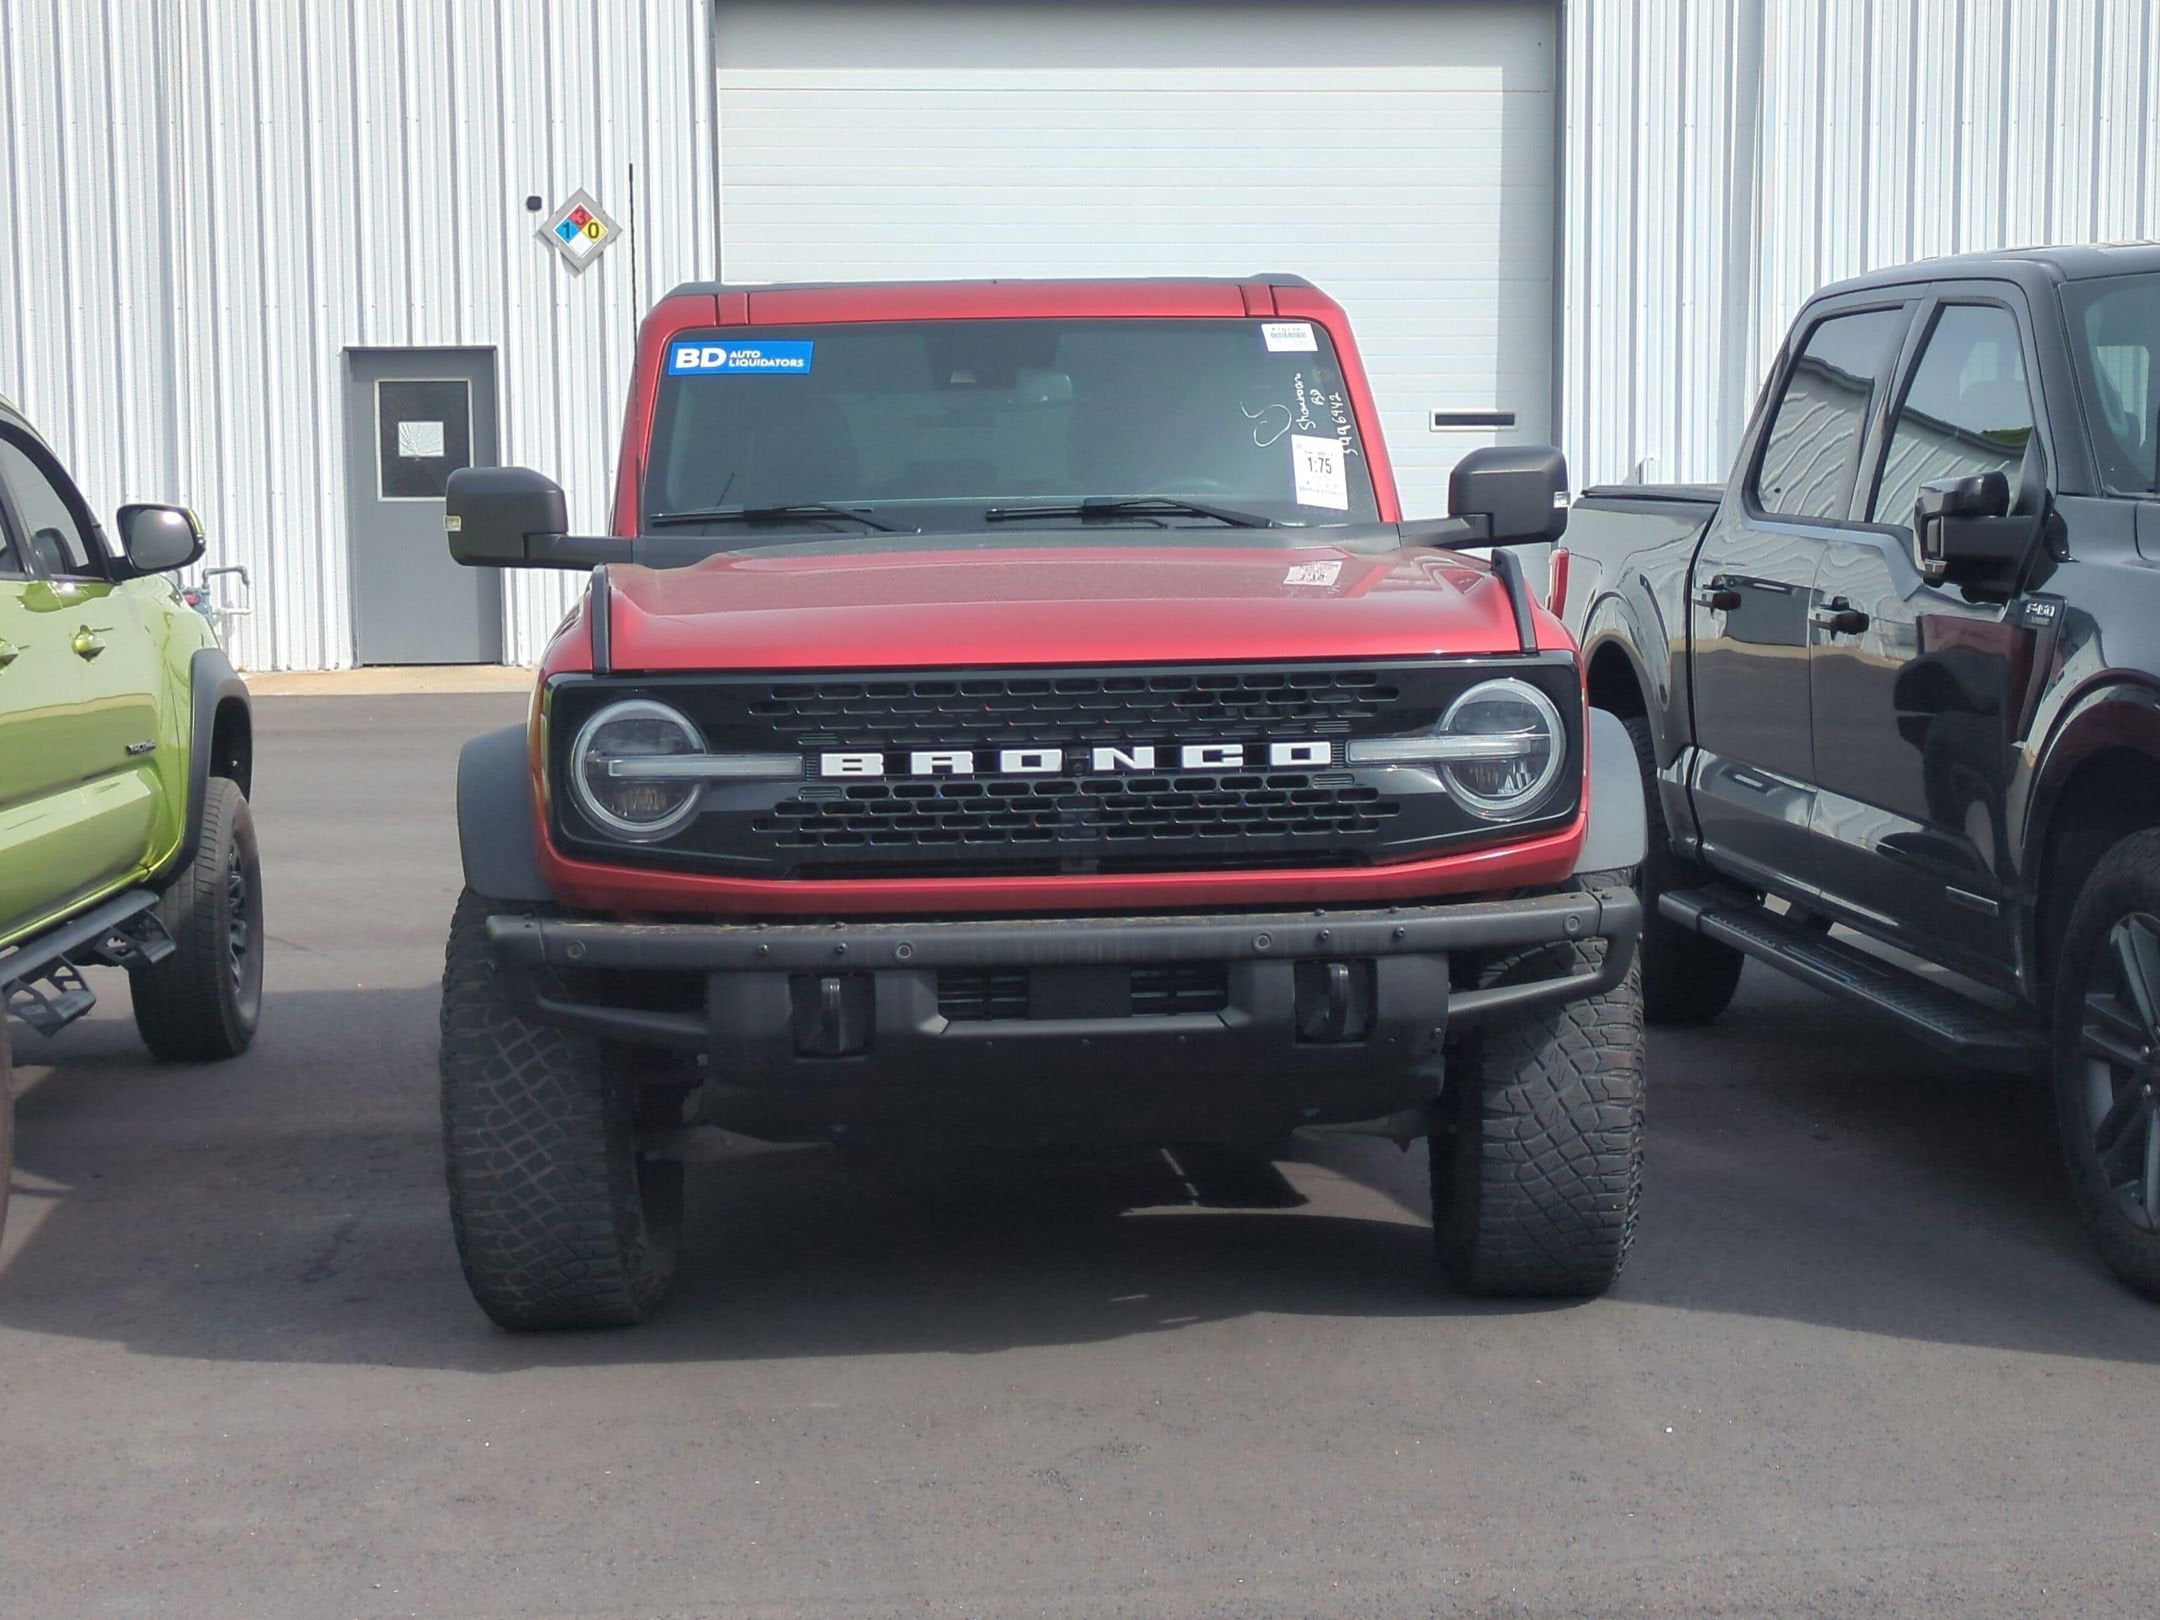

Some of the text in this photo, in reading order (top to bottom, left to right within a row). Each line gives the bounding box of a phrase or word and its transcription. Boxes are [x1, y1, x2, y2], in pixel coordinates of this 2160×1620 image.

[575, 208, 587, 227] 3
[561, 221, 571, 240] 1
[587, 221, 600, 239] 0
[675, 347, 727, 369] BD
[728, 358, 804, 368] LIQUIDATORS
[729, 350, 761, 359] AUTO
[820, 740, 1332, 777] BRONCO
